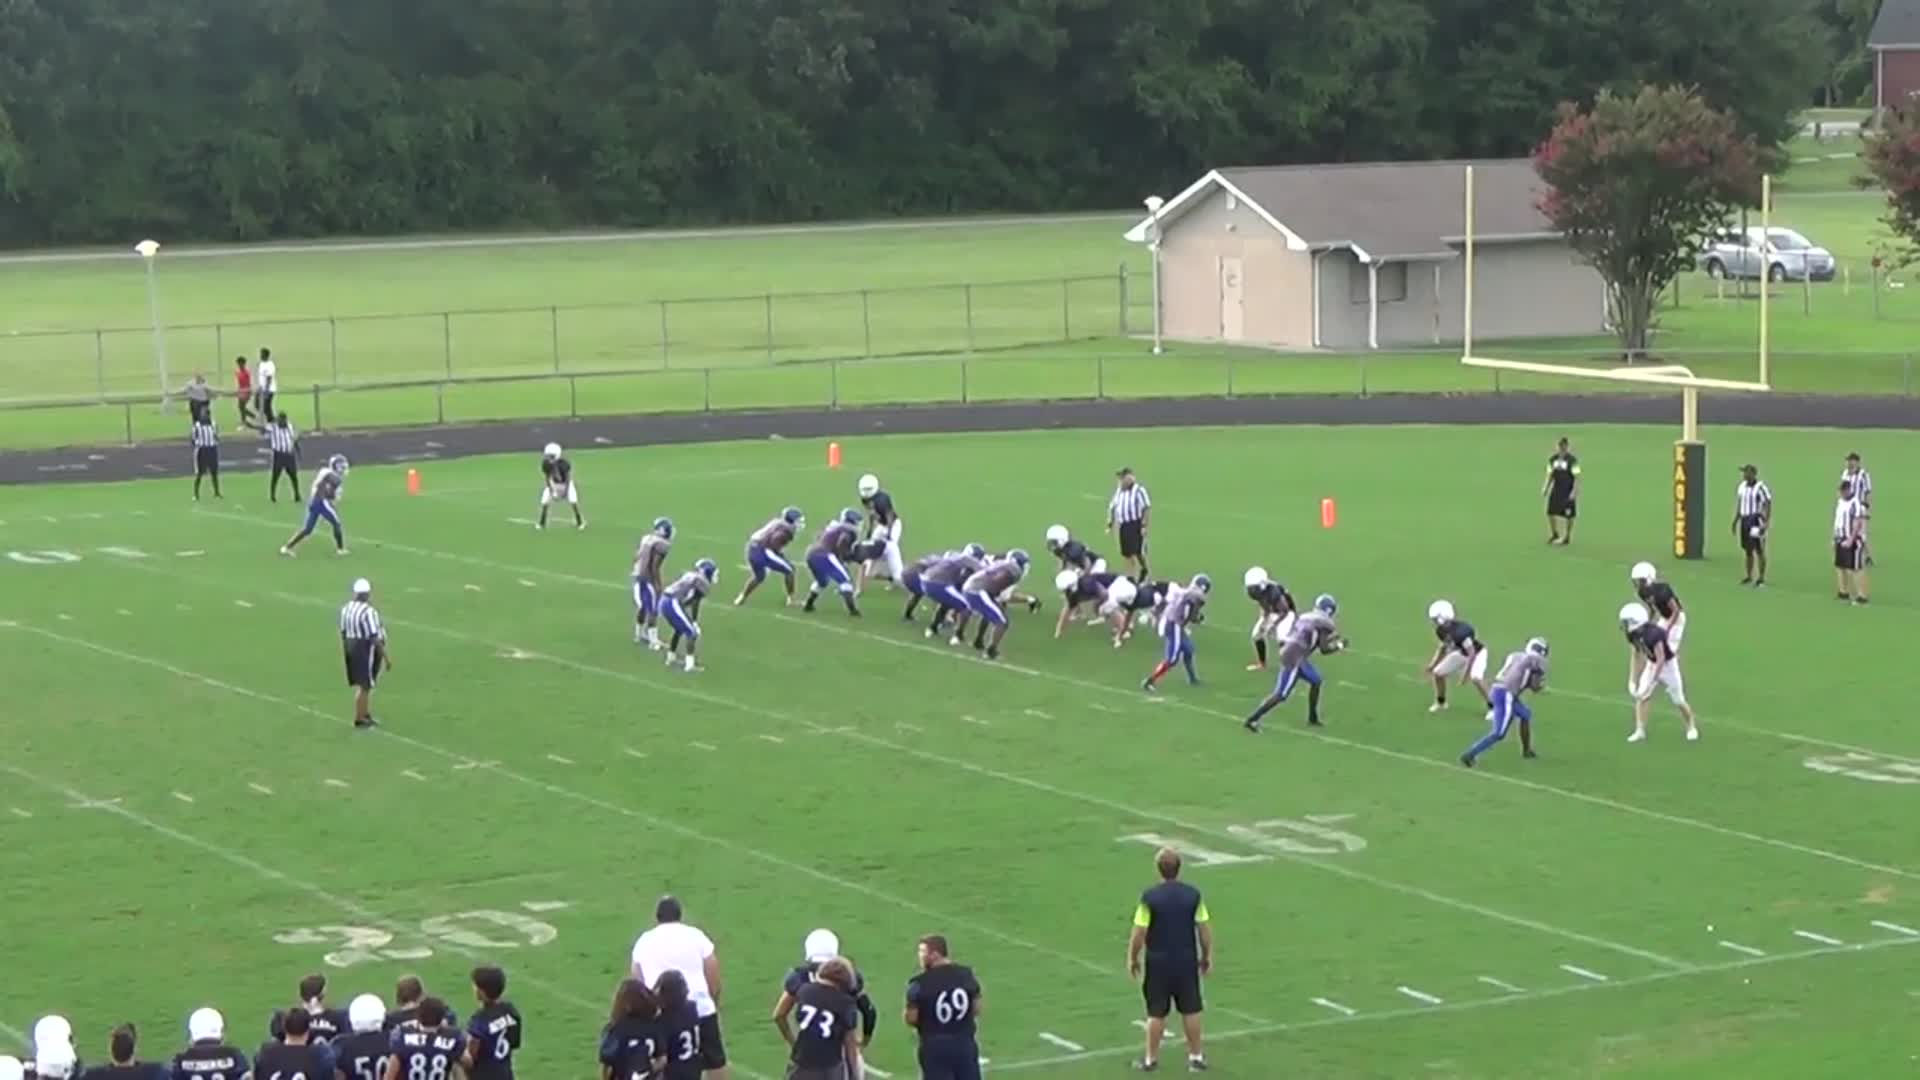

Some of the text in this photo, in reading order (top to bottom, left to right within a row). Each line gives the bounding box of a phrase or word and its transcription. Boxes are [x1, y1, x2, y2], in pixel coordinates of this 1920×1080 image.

[1674, 445, 1686, 556] EAGLES
[799, 1004, 835, 1038] 73
[936, 987, 969, 1024] 69
[408, 1053, 447, 1080] 88
